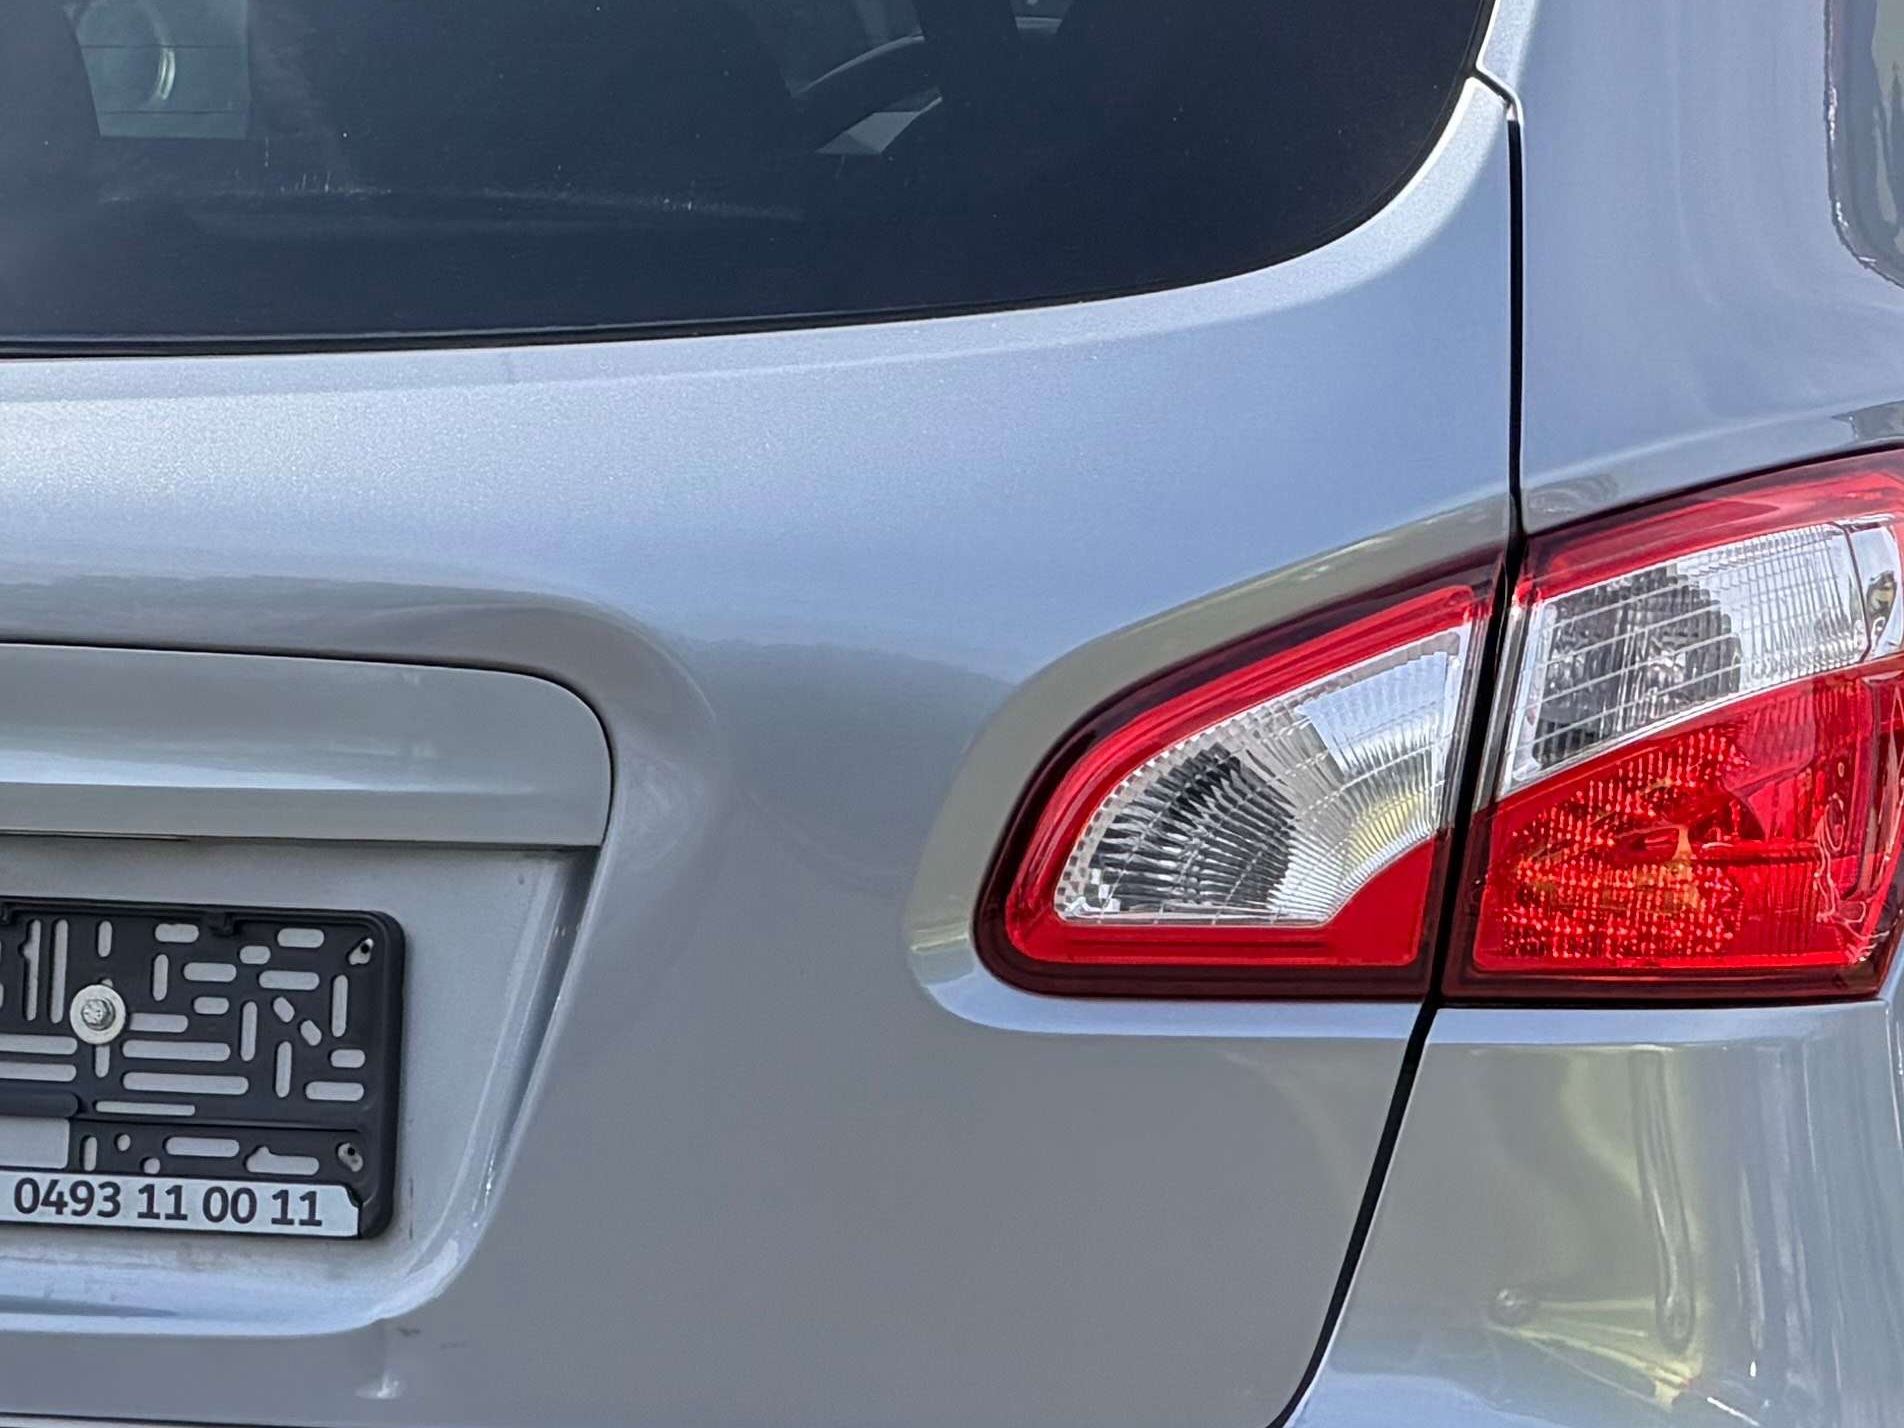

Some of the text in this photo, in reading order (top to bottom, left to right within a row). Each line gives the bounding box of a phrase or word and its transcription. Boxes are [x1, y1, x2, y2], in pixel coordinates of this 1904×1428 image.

[13, 1176, 122, 1219] 0493
[137, 1183, 188, 1221] 11
[202, 1185, 257, 1225] 00
[271, 1188, 324, 1227] 11
